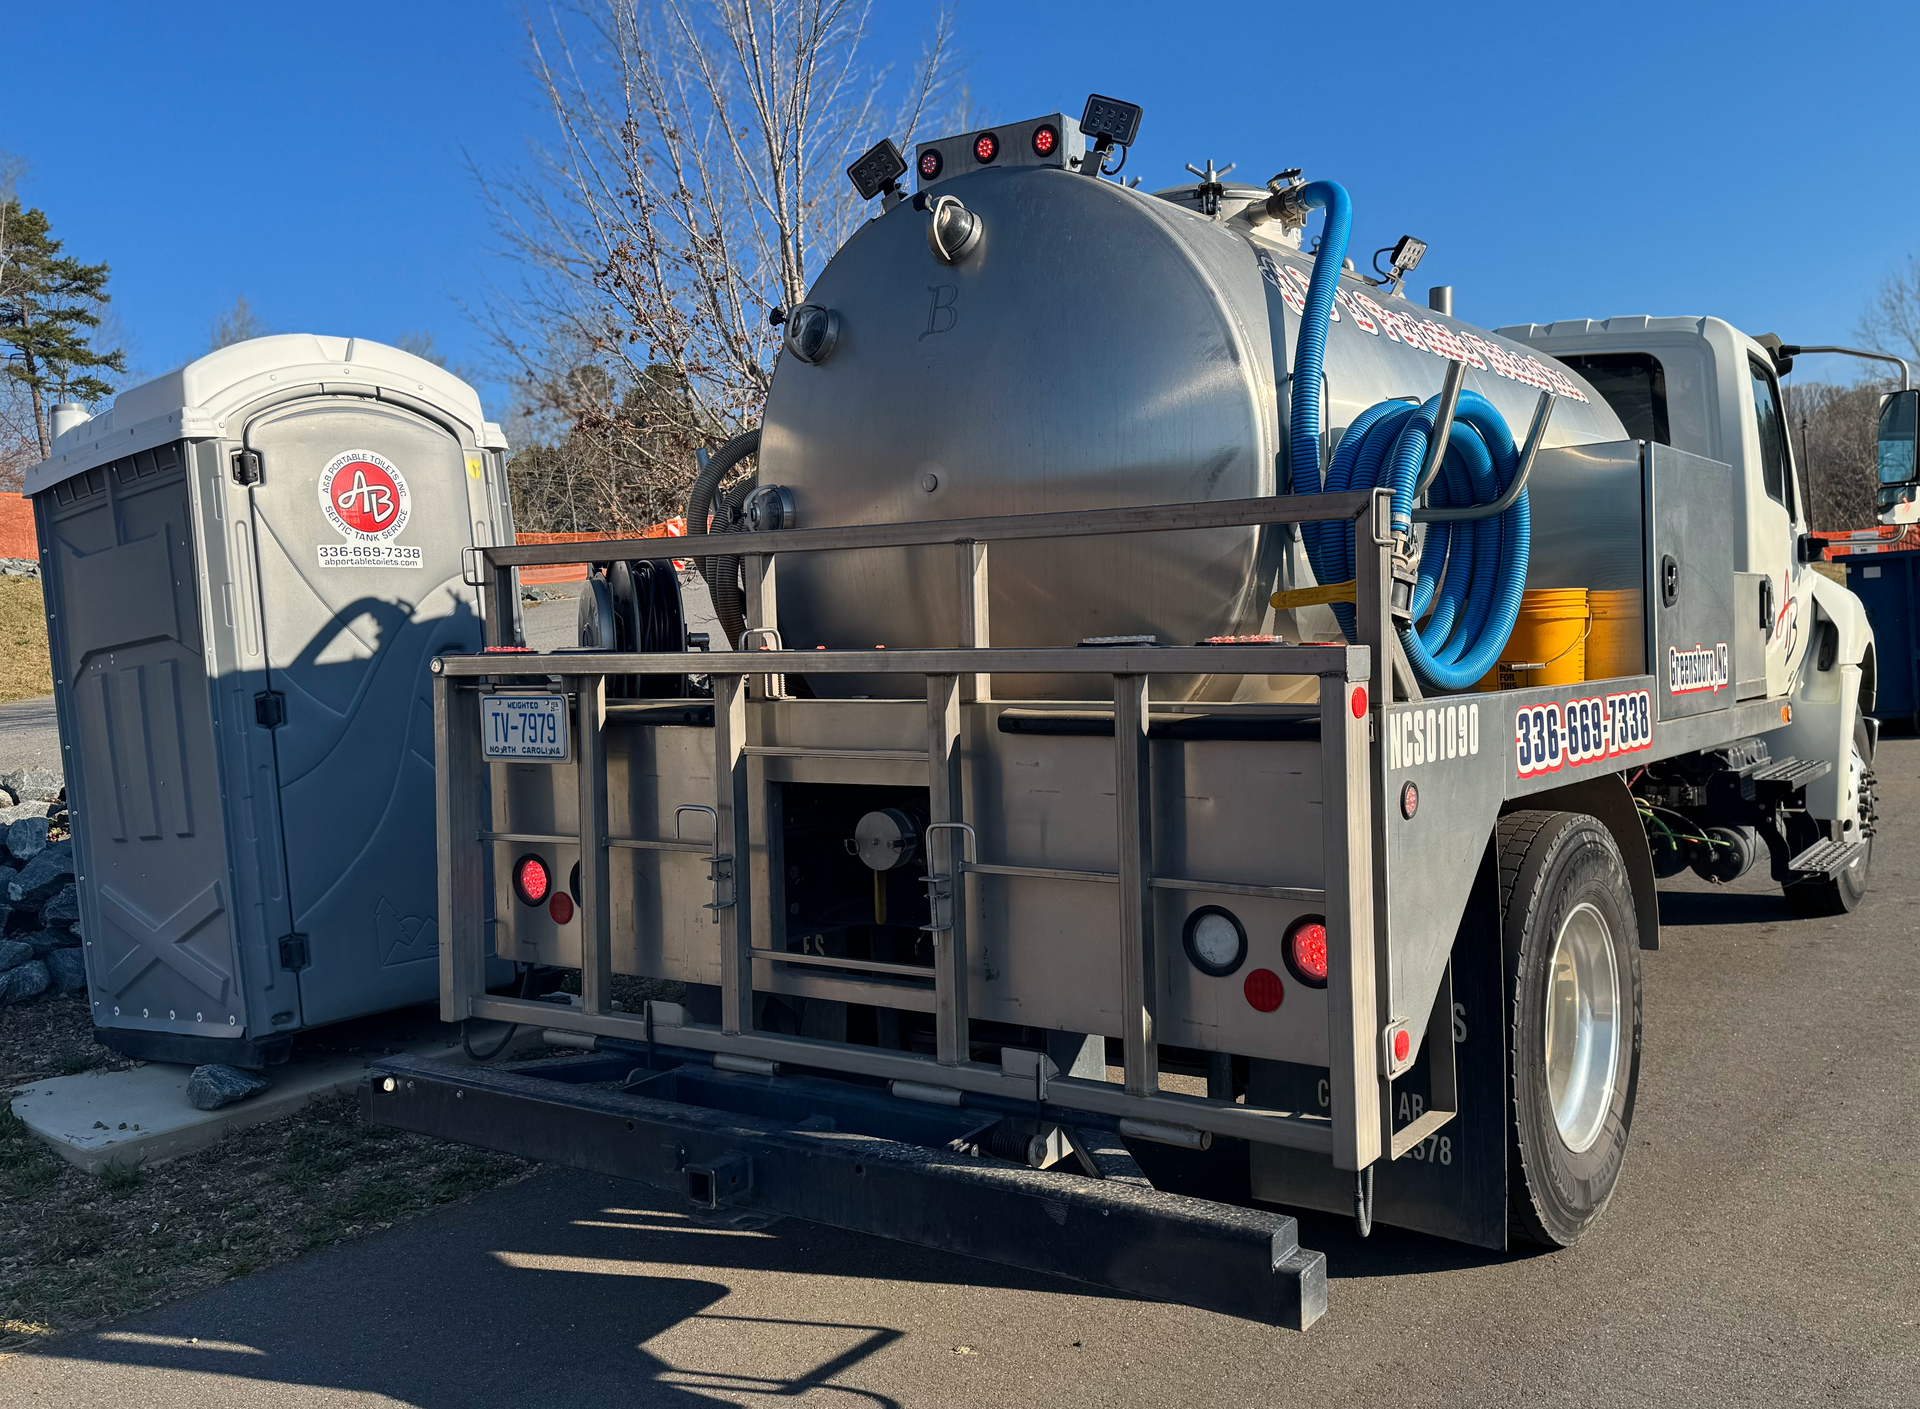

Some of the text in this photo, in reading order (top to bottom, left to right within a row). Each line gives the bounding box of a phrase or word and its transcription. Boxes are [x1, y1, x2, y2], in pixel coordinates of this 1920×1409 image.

[329, 453, 368, 474] PORTABLE
[370, 454, 400, 481] TOILETS
[325, 505, 408, 541] SEPTIC TANK SERVICE
[319, 546, 421, 558] 336-669-7338
[324, 557, 418, 567] abportabletoilets.com
[1500, 673, 1515, 681] FOR
[507, 701, 538, 709] WEIGHTED
[492, 712, 556, 744] TV-7979
[1517, 692, 1651, 773] 336-669-7338
[489, 745, 560, 754] NORTH CAROLINA
